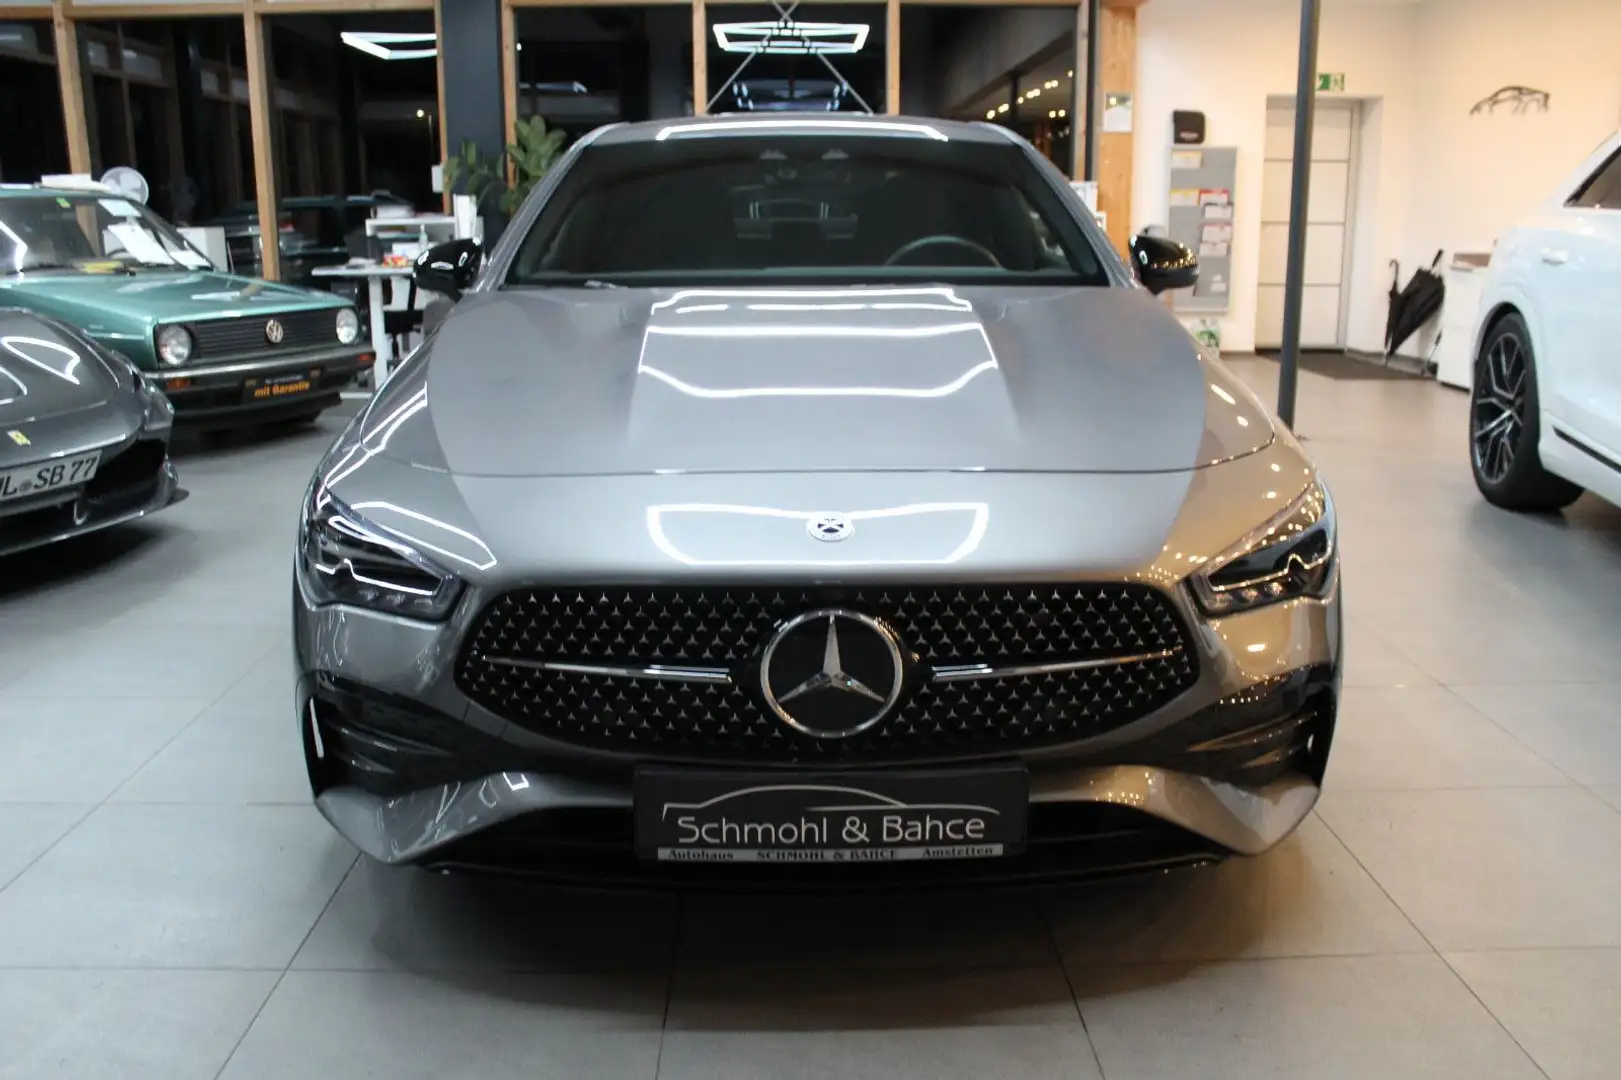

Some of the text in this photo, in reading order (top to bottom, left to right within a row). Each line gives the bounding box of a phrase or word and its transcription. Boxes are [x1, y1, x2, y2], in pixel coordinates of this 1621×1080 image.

[0, 456, 98, 497] L SB 77
[677, 814, 986, 845] Schmohl & Bahce
[668, 849, 735, 861] Autohaus
[757, 849, 825, 861] SCHMOHL
[851, 849, 898, 861] BAHCE
[922, 845, 994, 859] Amstetten
